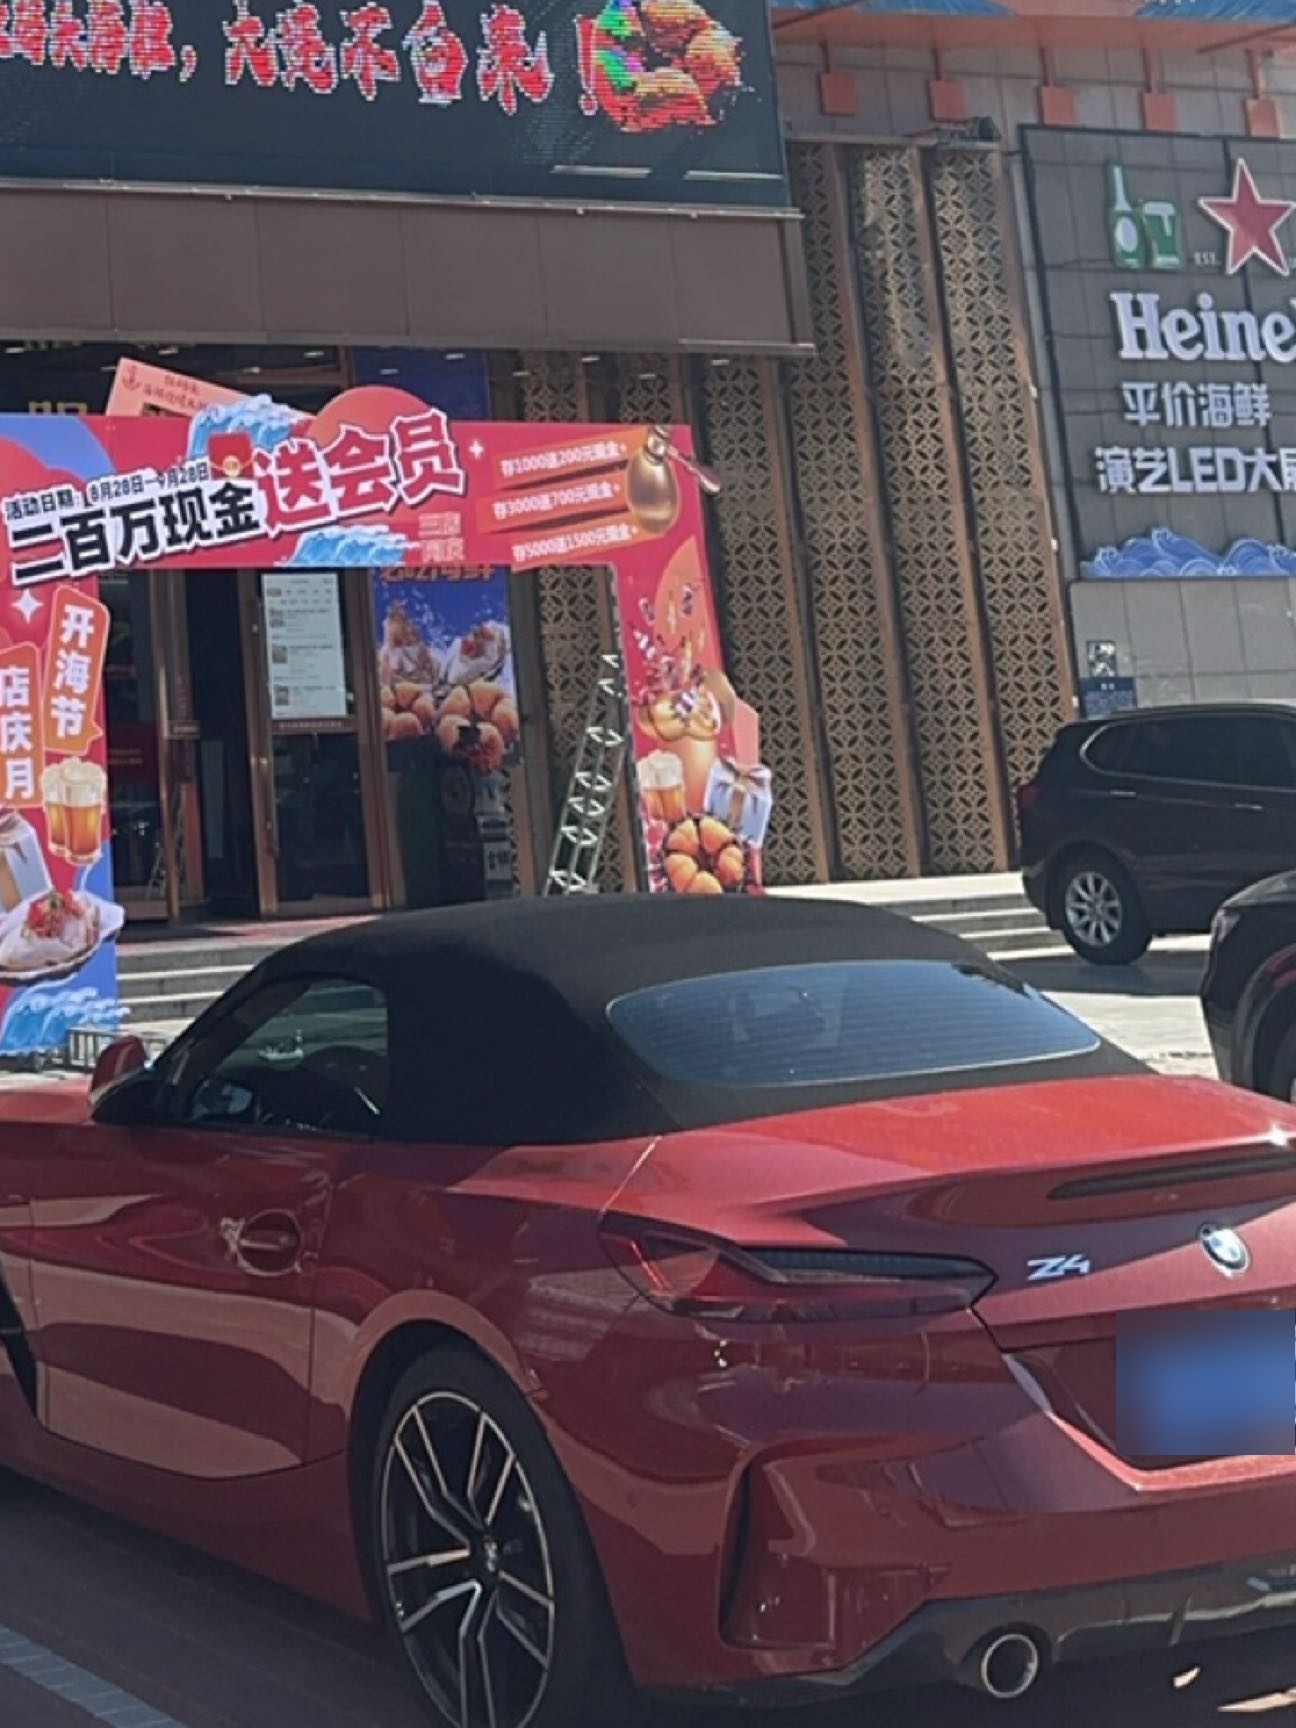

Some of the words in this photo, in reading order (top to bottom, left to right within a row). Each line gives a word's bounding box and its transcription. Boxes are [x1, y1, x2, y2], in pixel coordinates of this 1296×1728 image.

[1109, 290, 1296, 364] Heine
[1122, 381, 1272, 428] 平价海鲜
[49, 603, 95, 739] 开海节
[1027, 1253, 1092, 1281] Z4
